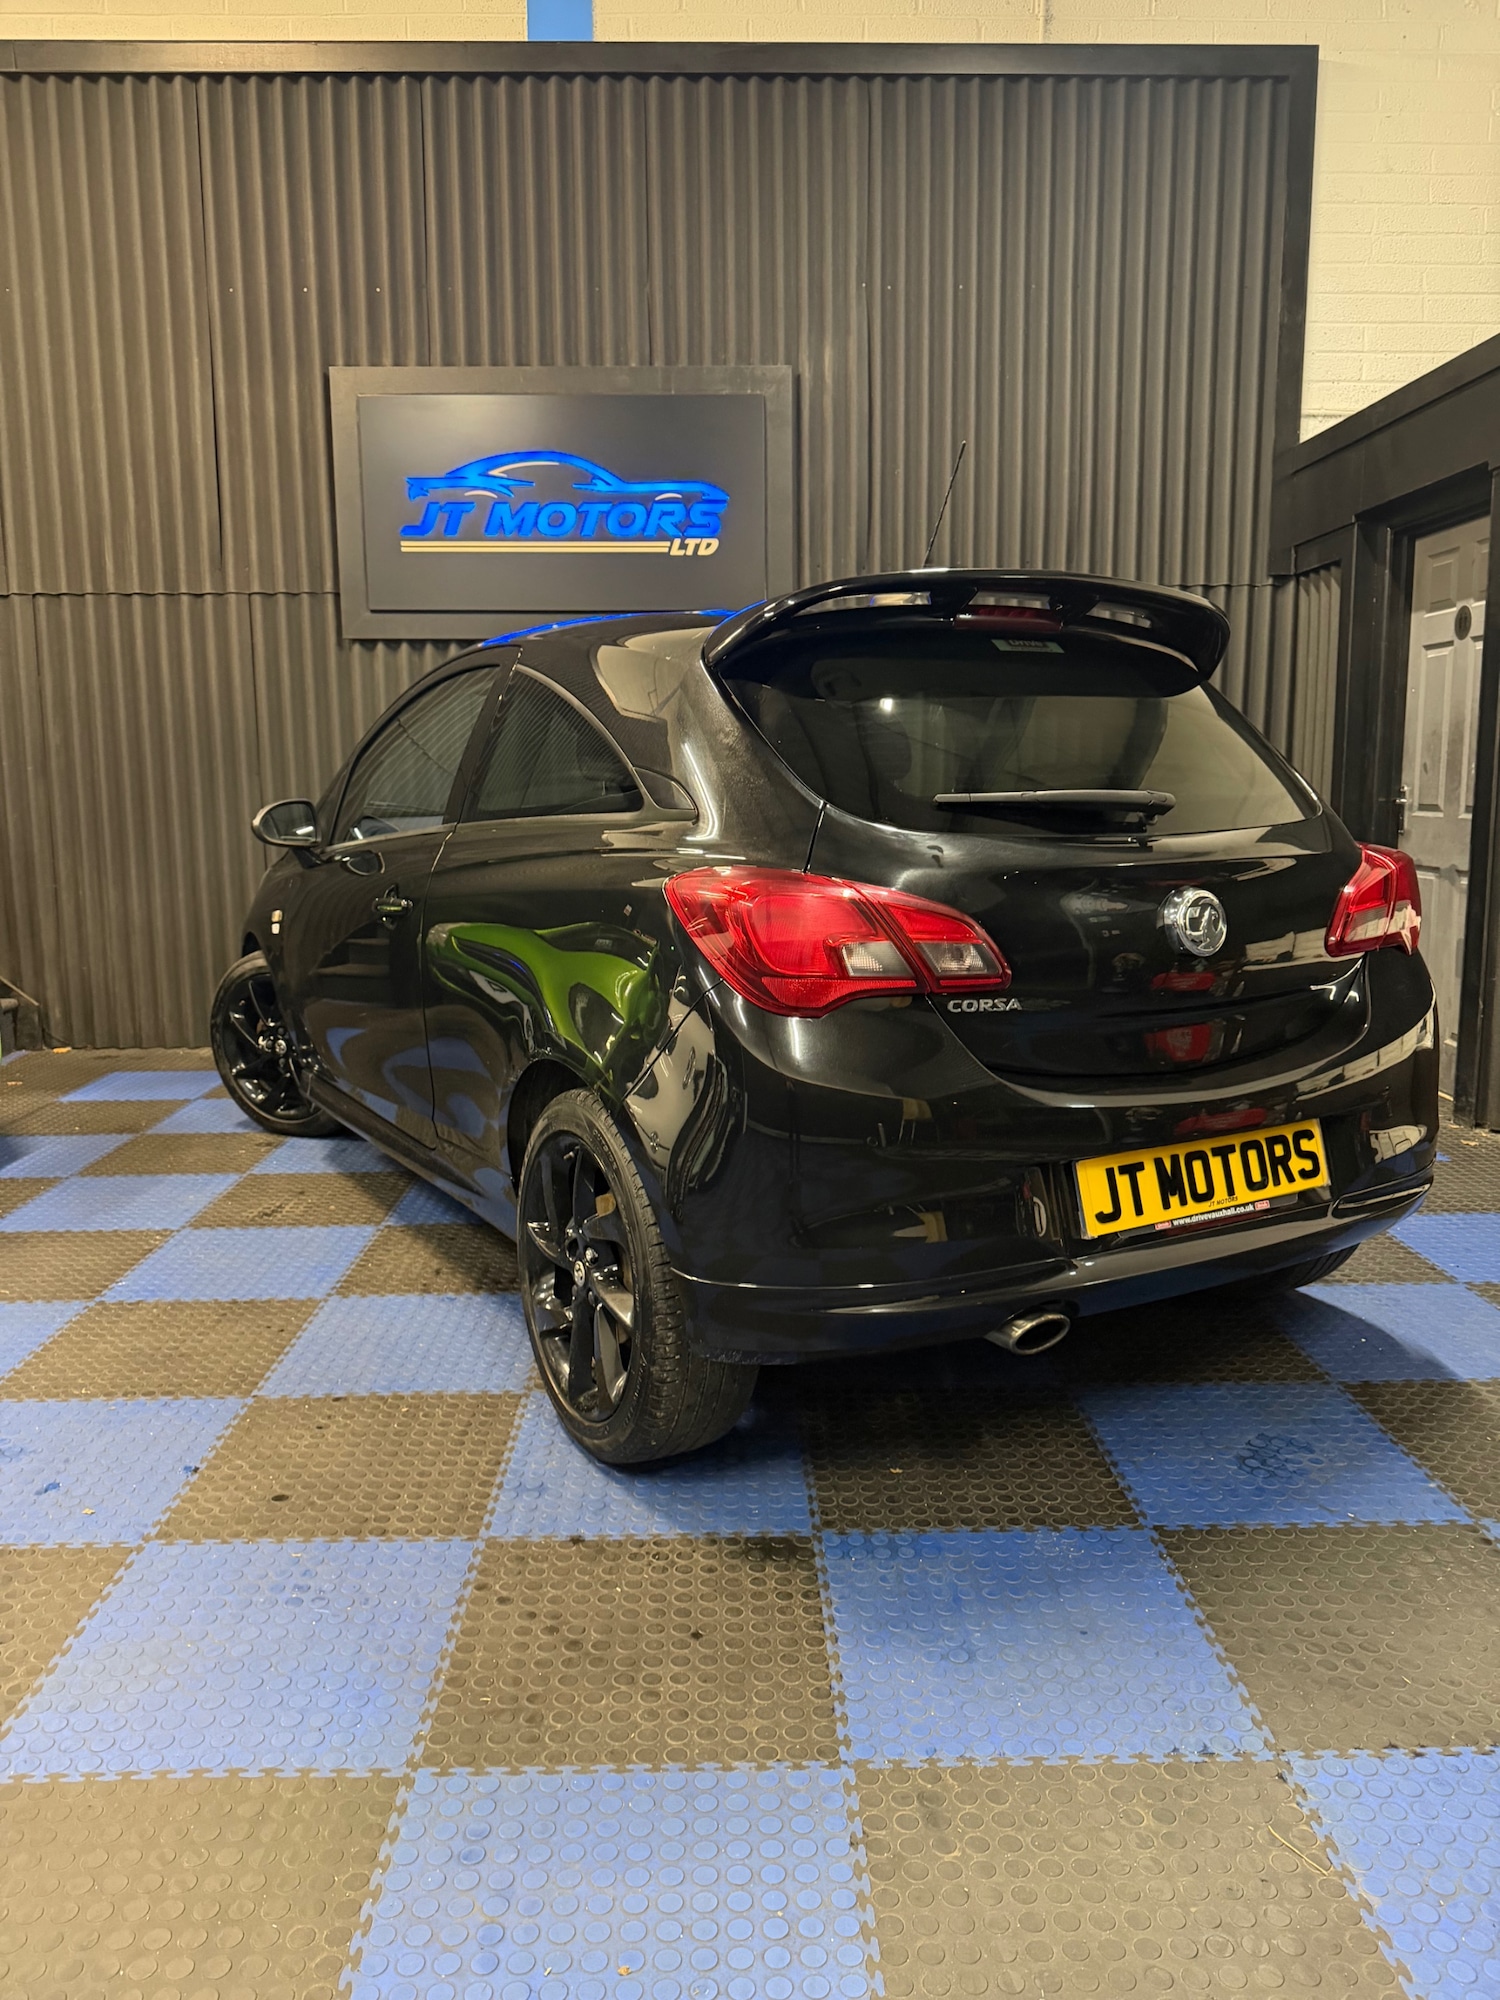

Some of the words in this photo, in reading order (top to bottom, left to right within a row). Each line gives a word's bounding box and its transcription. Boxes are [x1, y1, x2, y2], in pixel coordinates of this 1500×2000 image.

[400, 502, 476, 537] JT
[484, 500, 728, 538] MOTORS
[669, 537, 720, 557] LTD
[947, 998, 1022, 1013] CORSA
[1095, 1161, 1145, 1224] JT
[1153, 1129, 1321, 1210] MOTORS
[1216, 1196, 1238, 1206] MOTORS
[1172, 1203, 1255, 1226] www.drivevauxhall.co.uk
